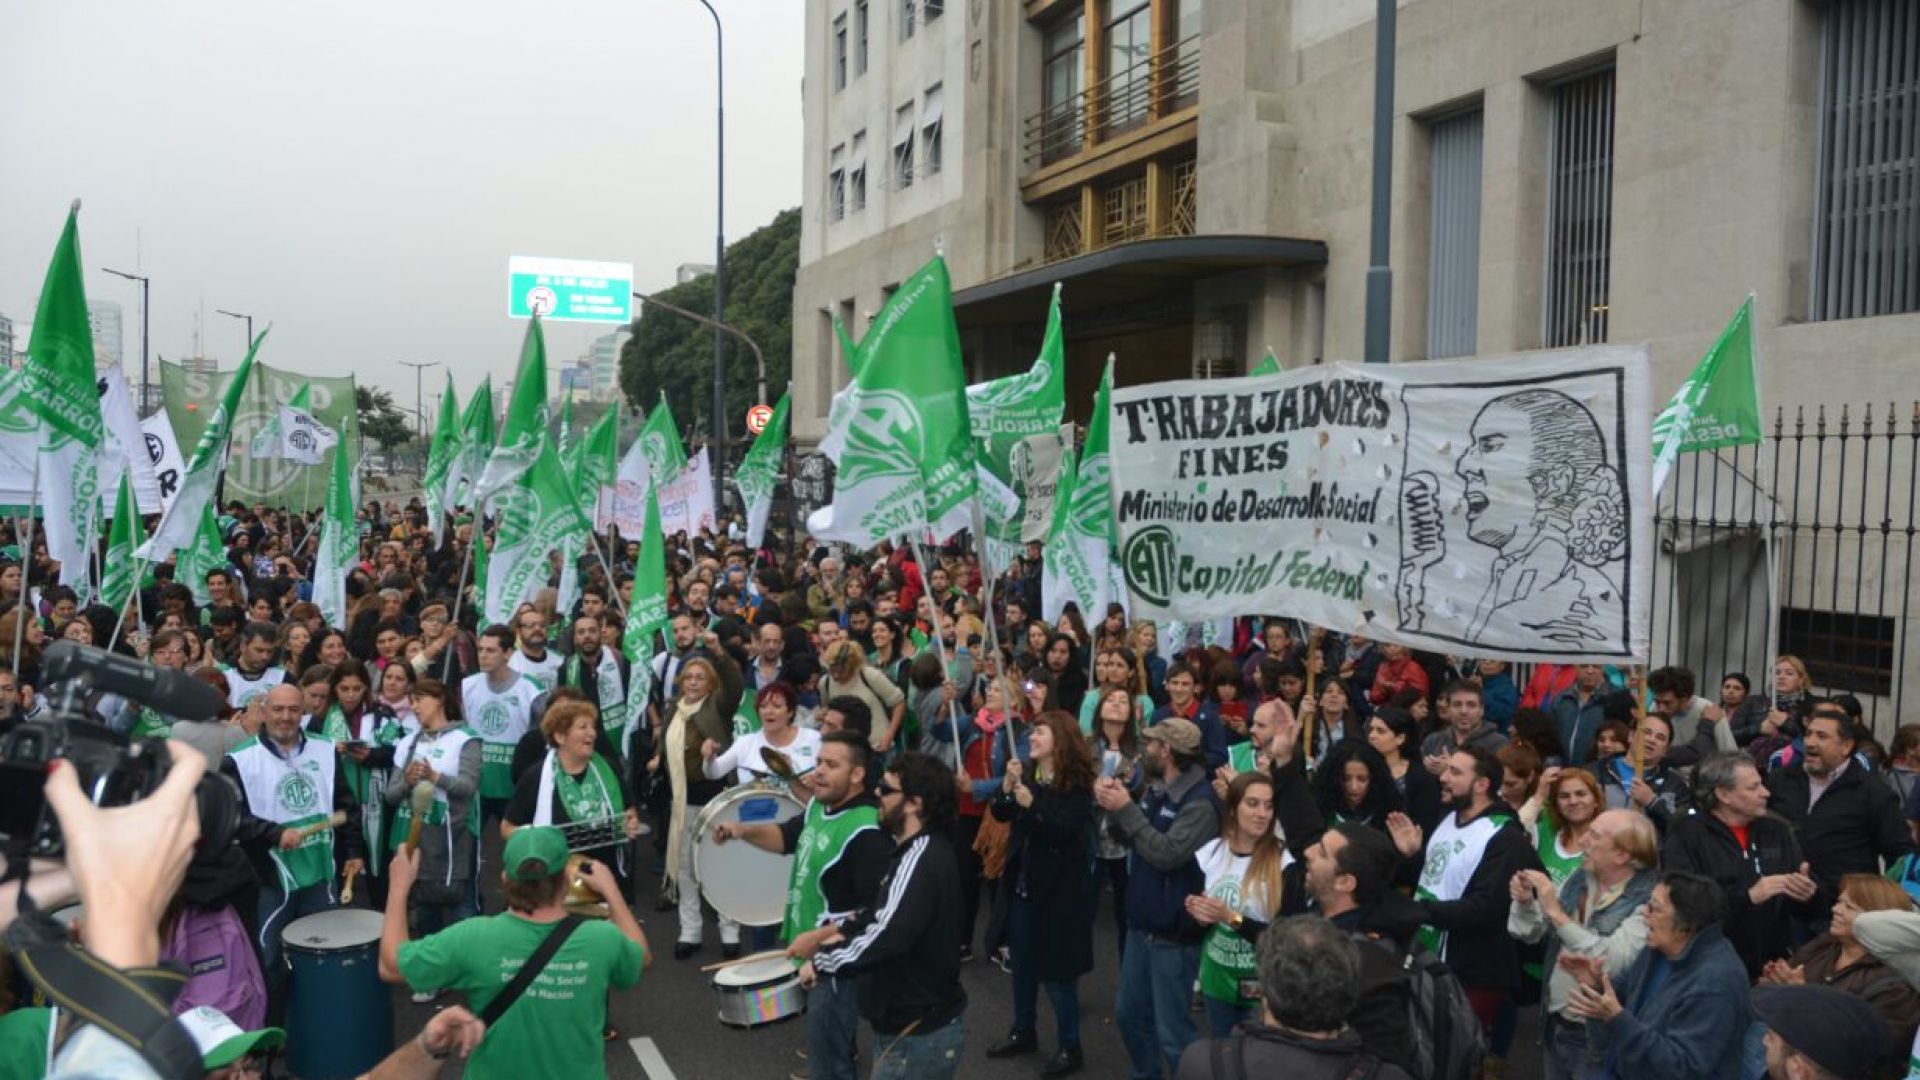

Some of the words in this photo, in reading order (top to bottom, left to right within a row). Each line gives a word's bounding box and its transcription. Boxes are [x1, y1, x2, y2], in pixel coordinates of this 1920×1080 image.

[1114, 378, 1390, 443] TRABAJADORES
[1177, 440, 1289, 480] FINES
[1119, 489, 1207, 523] Ministerio
[1212, 488, 1237, 523] de
[1327, 481, 1382, 525] Social
[1177, 550, 1283, 600] Capital
